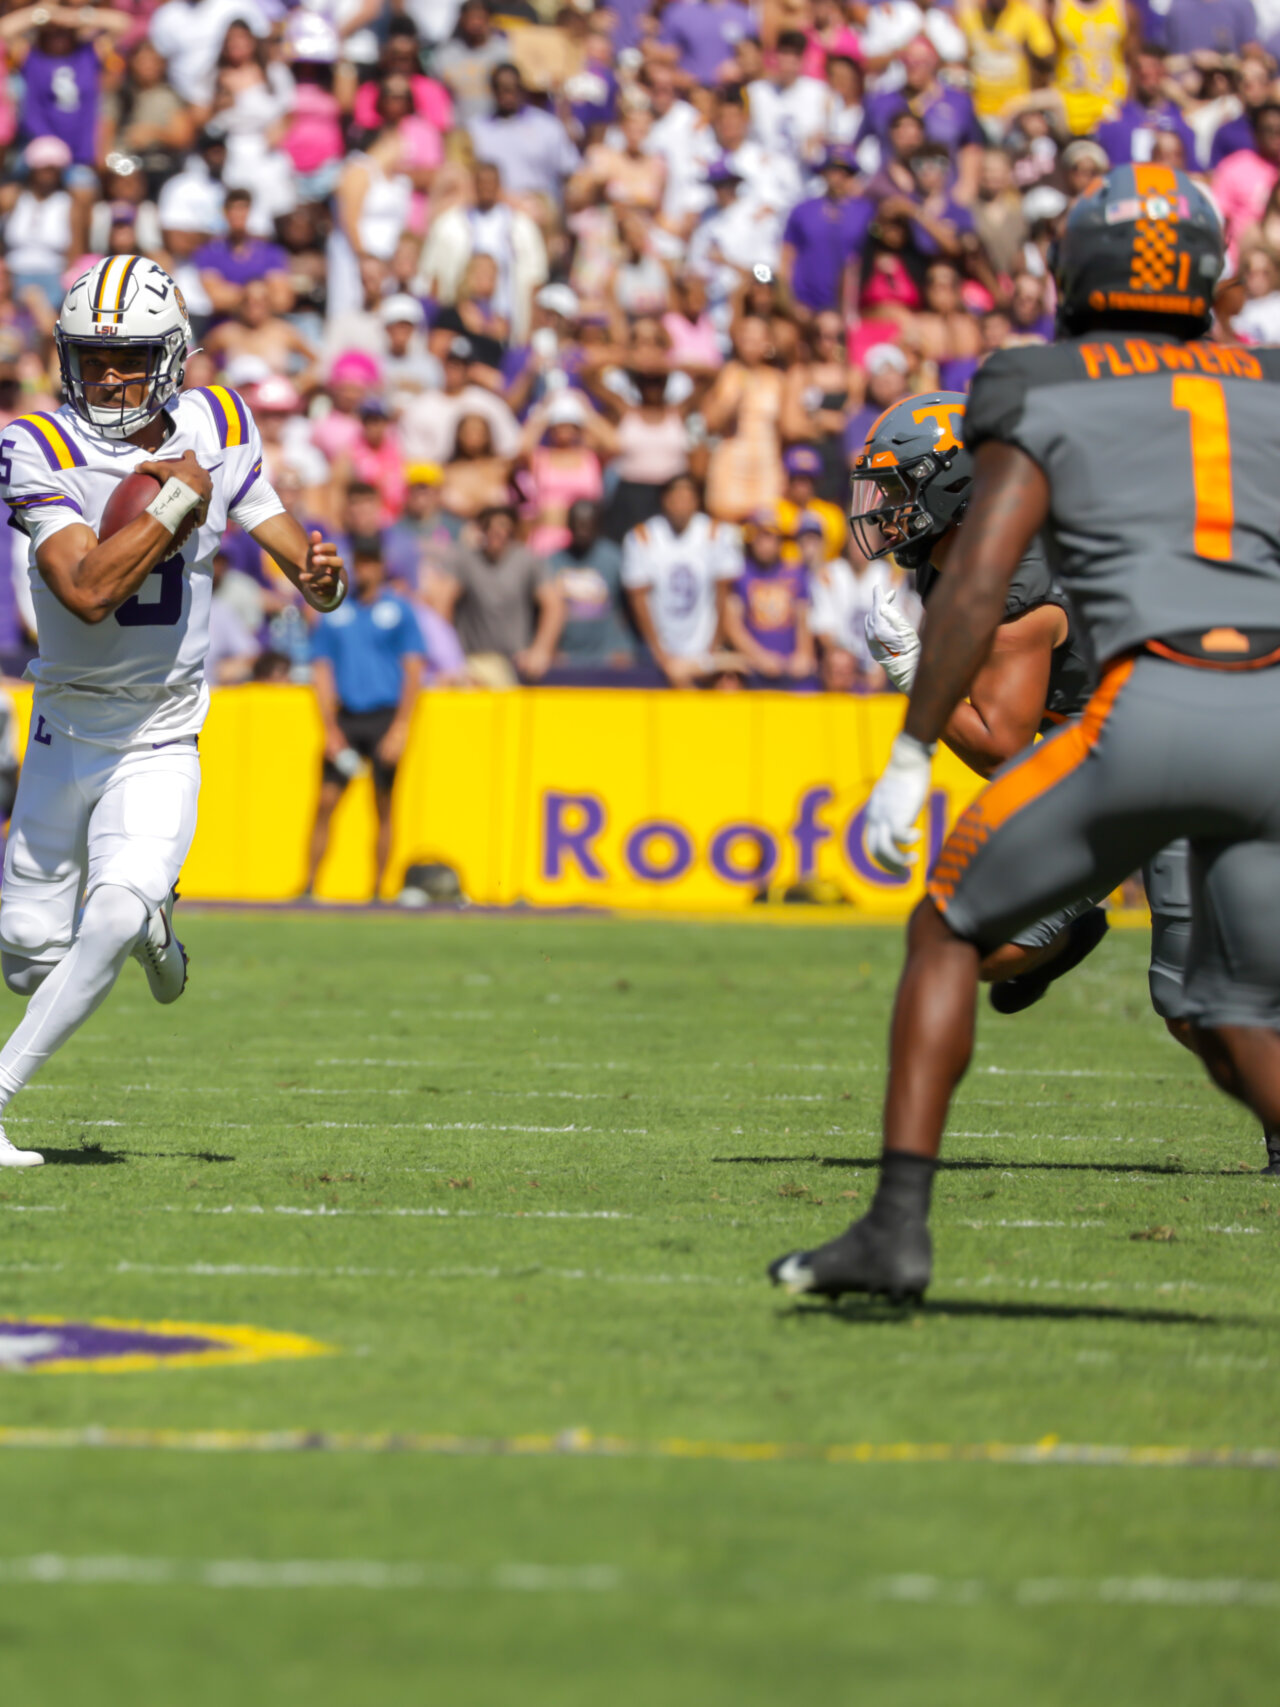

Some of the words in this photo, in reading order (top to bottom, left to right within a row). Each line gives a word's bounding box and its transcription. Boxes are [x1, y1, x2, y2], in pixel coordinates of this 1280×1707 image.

[94, 324, 118, 336] LSU
[1078, 337, 1263, 381] FLOWERS
[1171, 373, 1235, 562] 1
[33, 714, 52, 746] L
[544, 787, 946, 885] RoofCl
